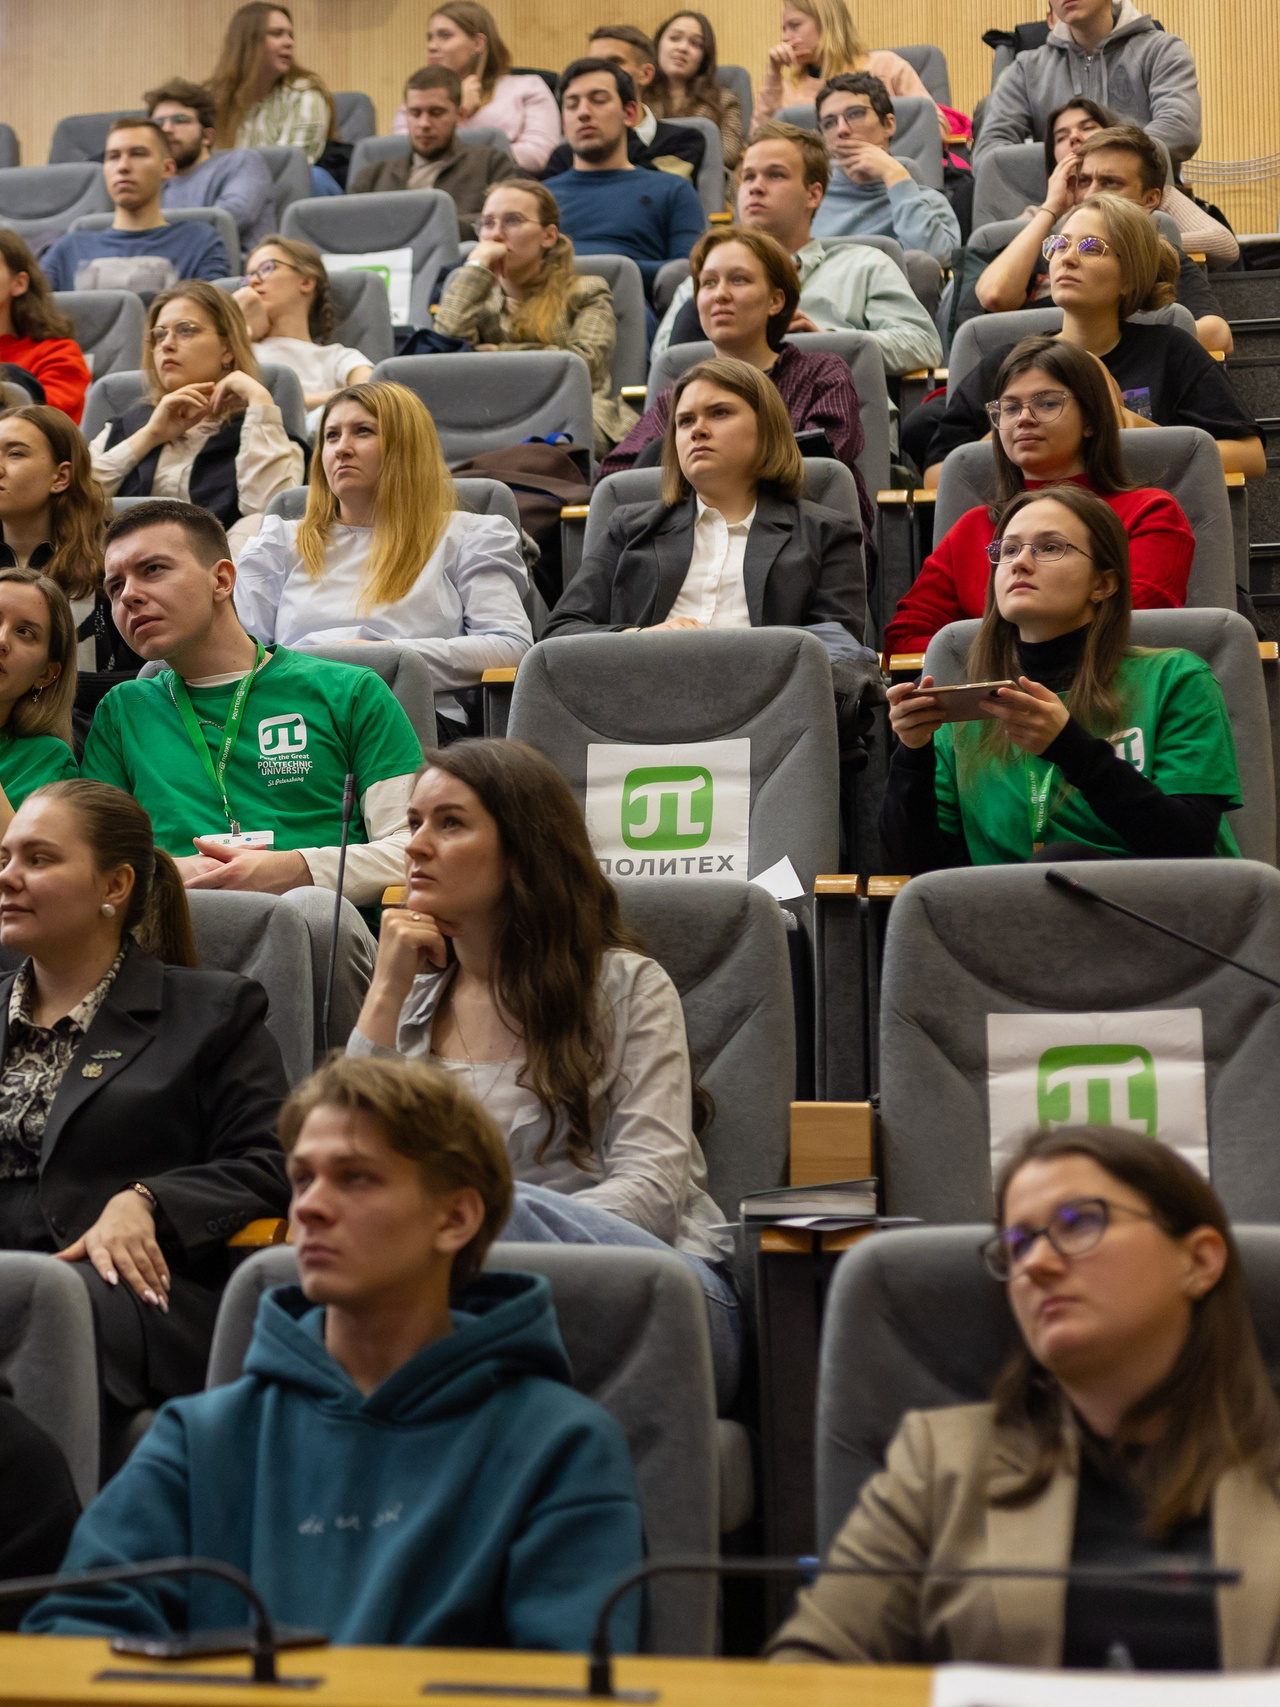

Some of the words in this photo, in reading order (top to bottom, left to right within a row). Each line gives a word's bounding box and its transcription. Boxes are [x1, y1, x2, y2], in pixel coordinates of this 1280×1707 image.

[258, 761, 313, 769] POLYTECHNIC
[261, 767, 310, 775] UNIVERSITY
[1036, 802, 1044, 832] POLYTECH
